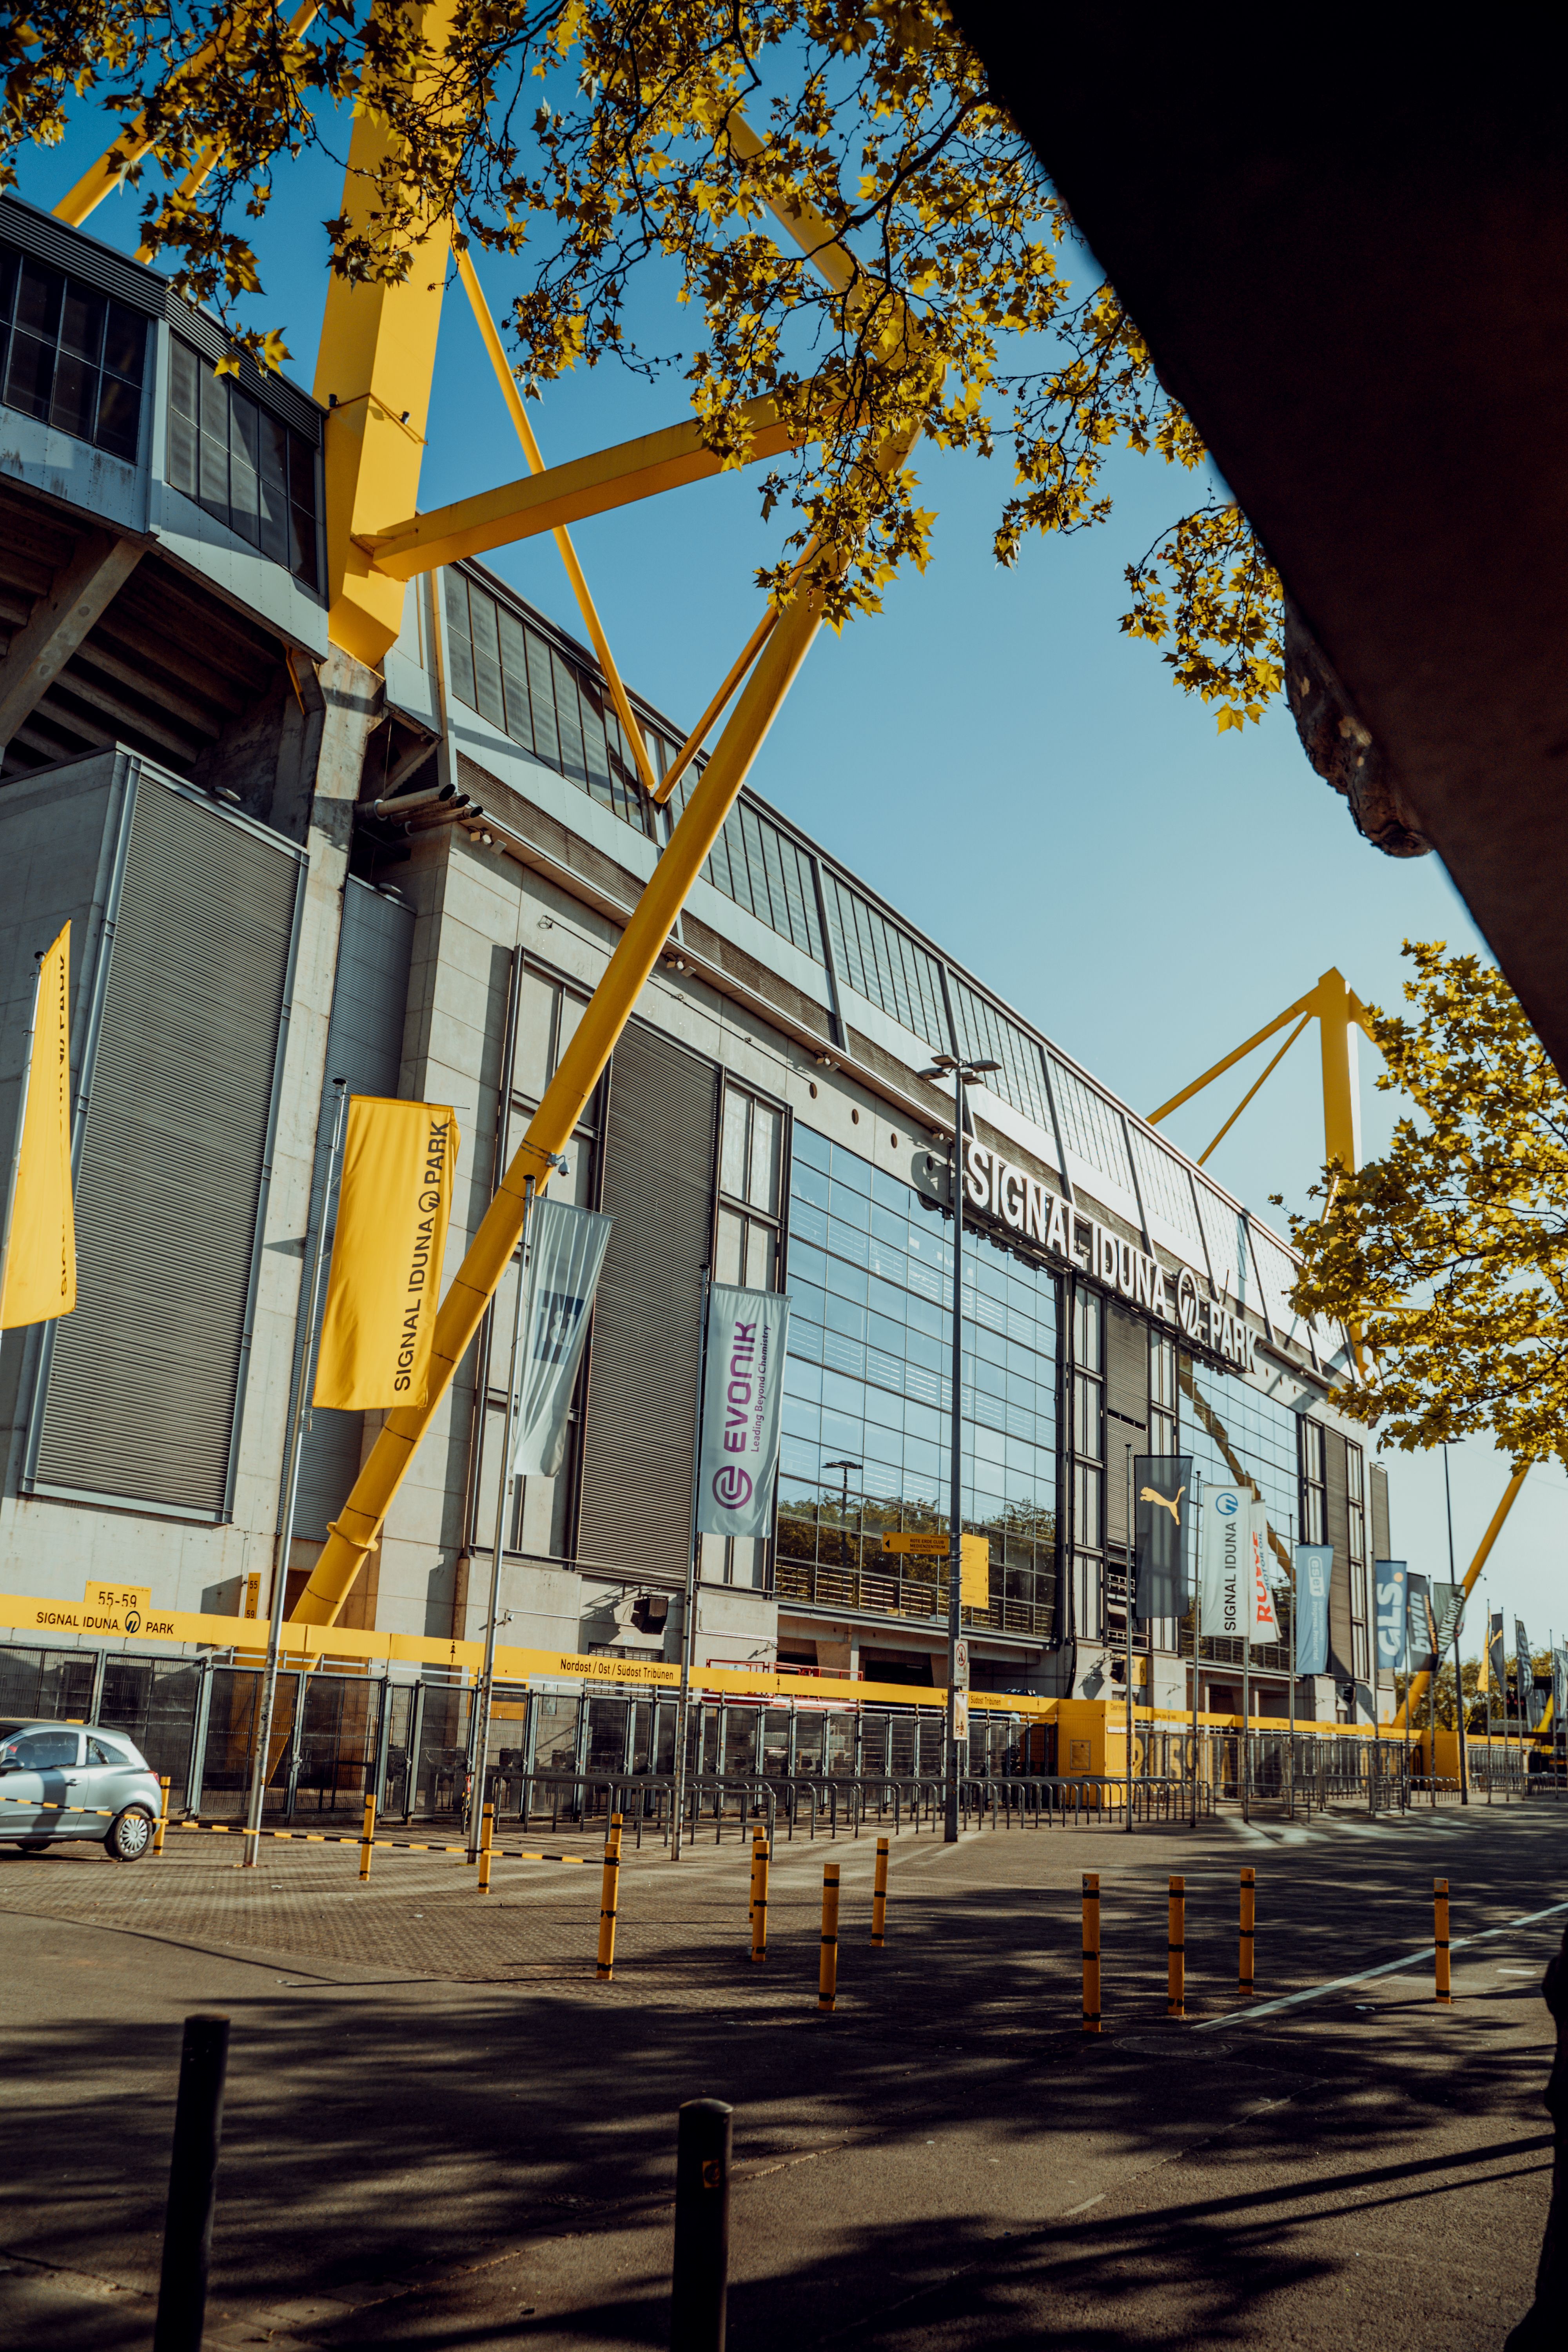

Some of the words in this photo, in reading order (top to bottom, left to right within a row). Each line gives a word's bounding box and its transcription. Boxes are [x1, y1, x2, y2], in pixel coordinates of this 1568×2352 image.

[394, 1298, 421, 1392] SIGNAL
[408, 1218, 434, 1292] IDUNA
[424, 1121, 449, 1184] PARK
[965, 1140, 1087, 1270] SIGNAL
[1089, 1221, 1167, 1320] IDUNA
[1209, 1299, 1257, 1375] PARK
[541, 1307, 576, 1348] 1&1
[758, 1325, 771, 1374] Chemistry
[724, 1321, 757, 1452] EVONIK
[755, 1376, 766, 1412] Beyond
[751, 1414, 764, 1452] Leading
[1225, 1522, 1236, 1569] IDUNA
[250, 1581, 258, 1589] 55
[1260, 1552, 1270, 1591] MOTOR
[98, 1591, 137, 1608] 55-59
[246, 1610, 254, 1619] 59
[1225, 1574, 1236, 1631] SIGNAL
[36, 1612, 79, 1626] SIGNAL
[83, 1616, 118, 1630] IDUNA
[146, 1622, 174, 1634] PARK
[1407, 1591, 1432, 1654] bwin
[561, 1659, 591, 1673] Nordost
[599, 1662, 610, 1675] Ost
[617, 1665, 641, 1677] Südost
[644, 1667, 673, 1680] Tribünen
[971, 1695, 984, 1704] Südost
[985, 1697, 1001, 1706] Tribünen
